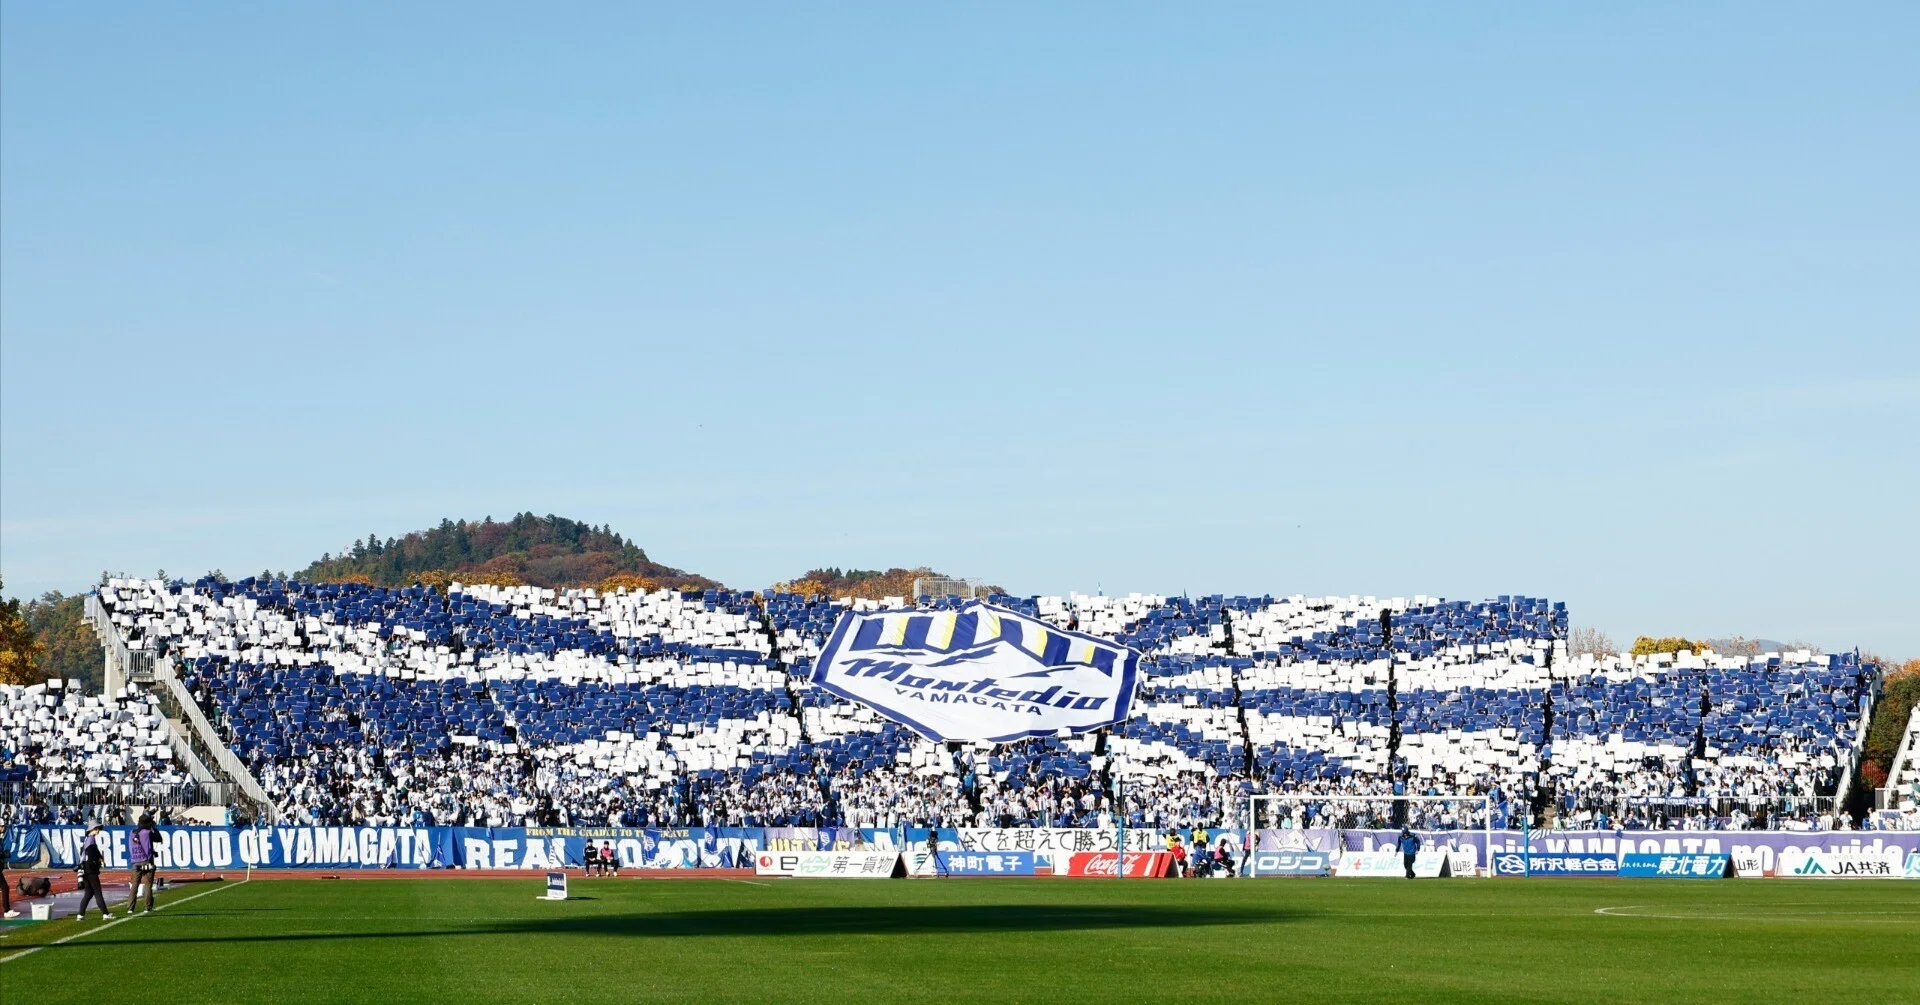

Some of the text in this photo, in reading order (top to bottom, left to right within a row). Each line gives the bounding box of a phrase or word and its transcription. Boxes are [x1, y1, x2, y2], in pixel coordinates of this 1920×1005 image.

[839, 658, 1109, 710] Montedio
[894, 688, 1043, 716] YAMAGATA
[525, 828, 554, 837] FROM
[557, 827, 577, 837] THE
[620, 828, 633, 837] TO
[150, 829, 232, 867] ROUD
[238, 828, 273, 865] OF
[278, 827, 432, 865] YAMAGATA
[831, 855, 895, 874] 第一貨物
[948, 855, 1023, 872] 神町電子
[1529, 857, 1617, 872] 所沢軽合金
[1656, 855, 1727, 875] 東北電力
[1830, 861, 1891, 875] JA共済
